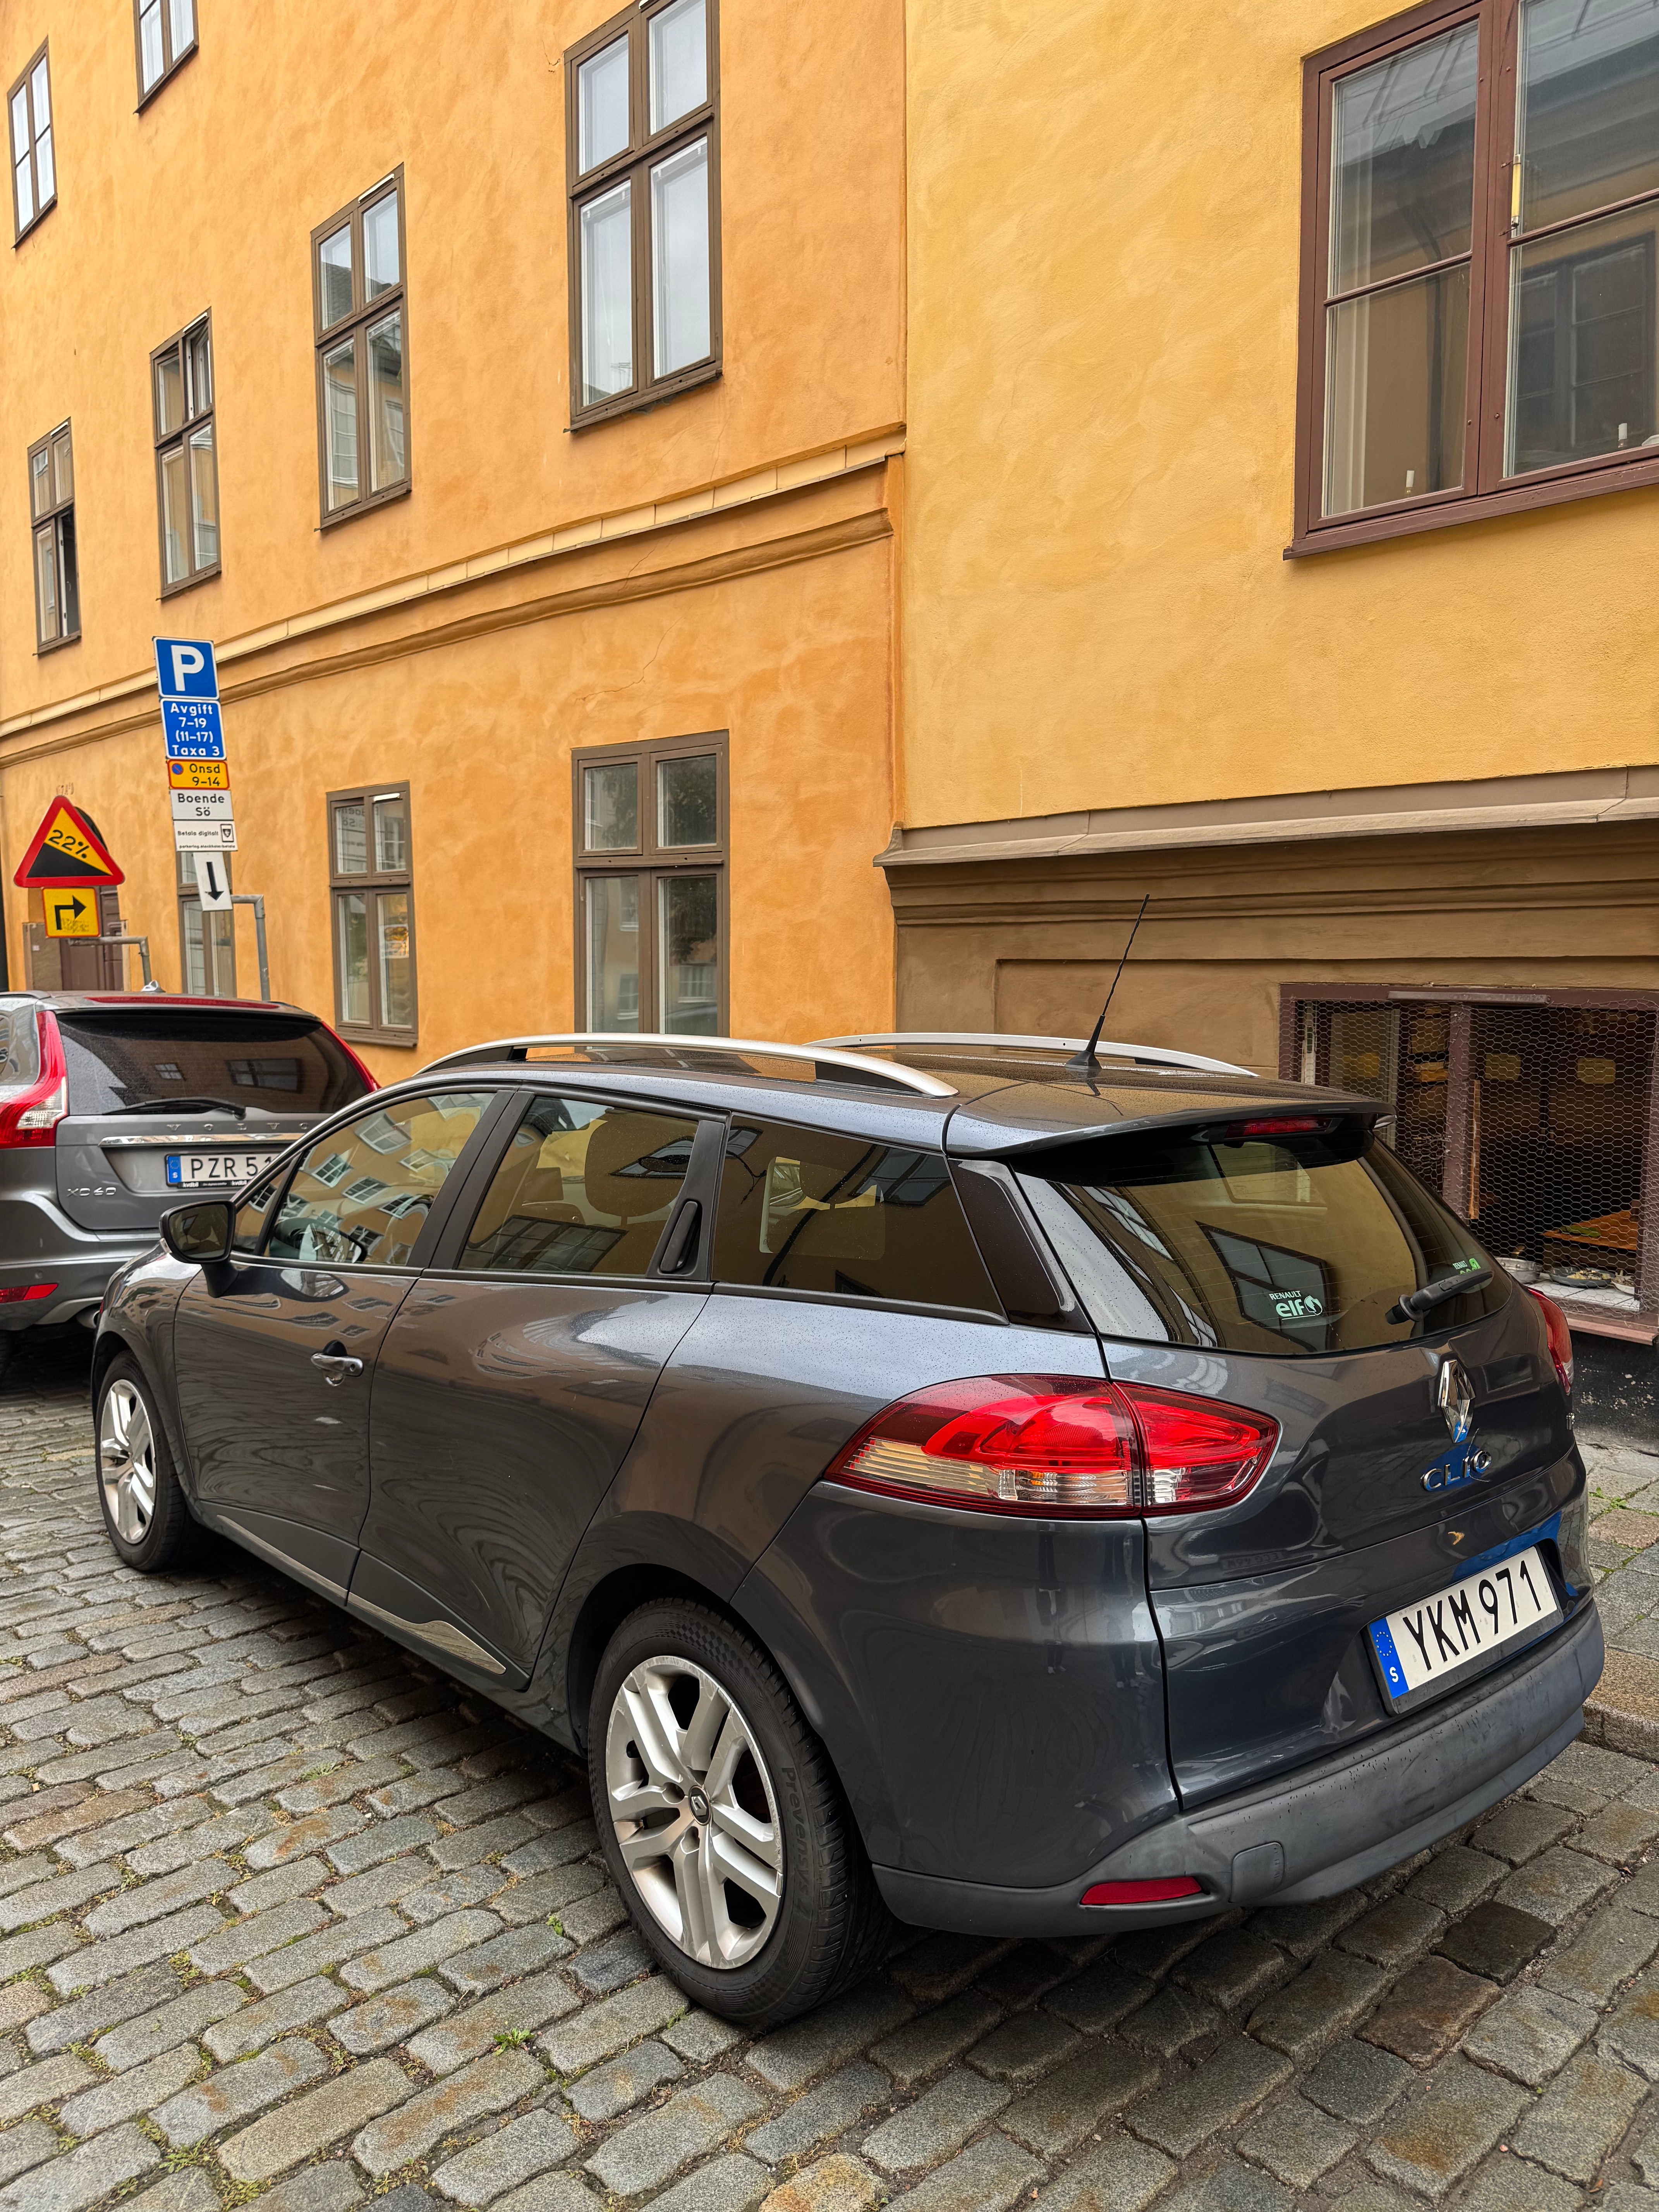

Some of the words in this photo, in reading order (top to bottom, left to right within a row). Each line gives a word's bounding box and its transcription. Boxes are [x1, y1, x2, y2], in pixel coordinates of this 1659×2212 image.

[171, 645, 204, 691] P
[170, 703, 213, 716] Avgift
[178, 717, 206, 728] 7-19
[175, 730, 213, 743] (11-17)
[172, 745, 206, 756] Taxa
[212, 746, 220, 756] 3
[189, 763, 220, 773] Onsd
[192, 776, 220, 786] 9-14
[178, 793, 225, 803] Boende
[196, 807, 210, 816] Sö
[48, 829, 89, 859] 22%
[167, 1123, 310, 1131] VOLVO
[191, 1158, 237, 1178] PZR
[1269, 1291, 1302, 1300] RENAULT
[1276, 1299, 1304, 1317] elf
[1421, 1450, 1492, 1492] CLIO
[1403, 1589, 1481, 1671] YKM
[1479, 1560, 1541, 1636] 971
[1389, 1666, 1398, 1683] S
